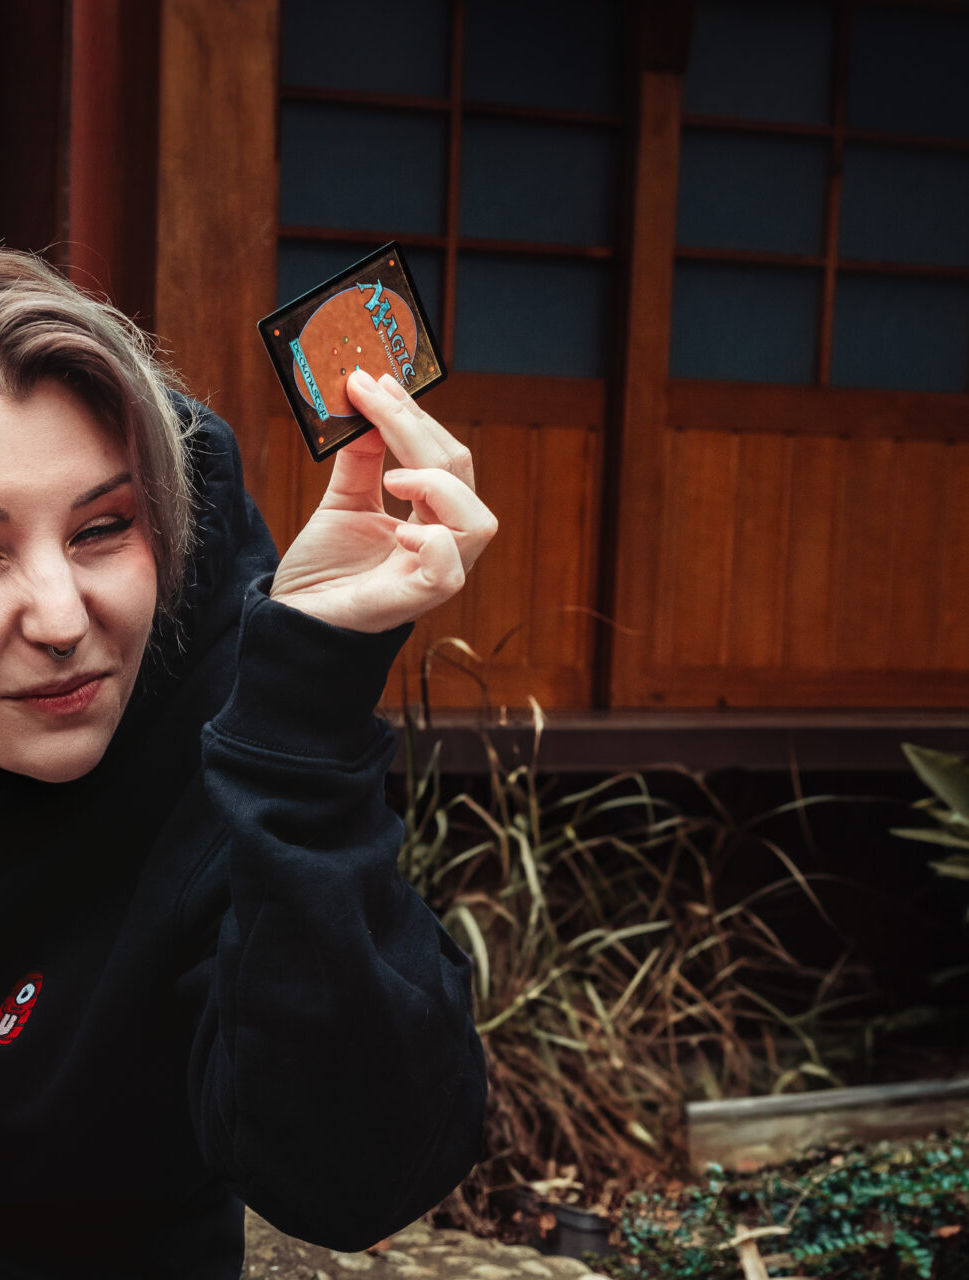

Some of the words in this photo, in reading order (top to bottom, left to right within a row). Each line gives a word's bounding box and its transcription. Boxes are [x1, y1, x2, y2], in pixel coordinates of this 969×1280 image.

[356, 278, 417, 386] MAGIC
[378, 329, 386, 343] The
[293, 341, 329, 419] DECKMASTER
